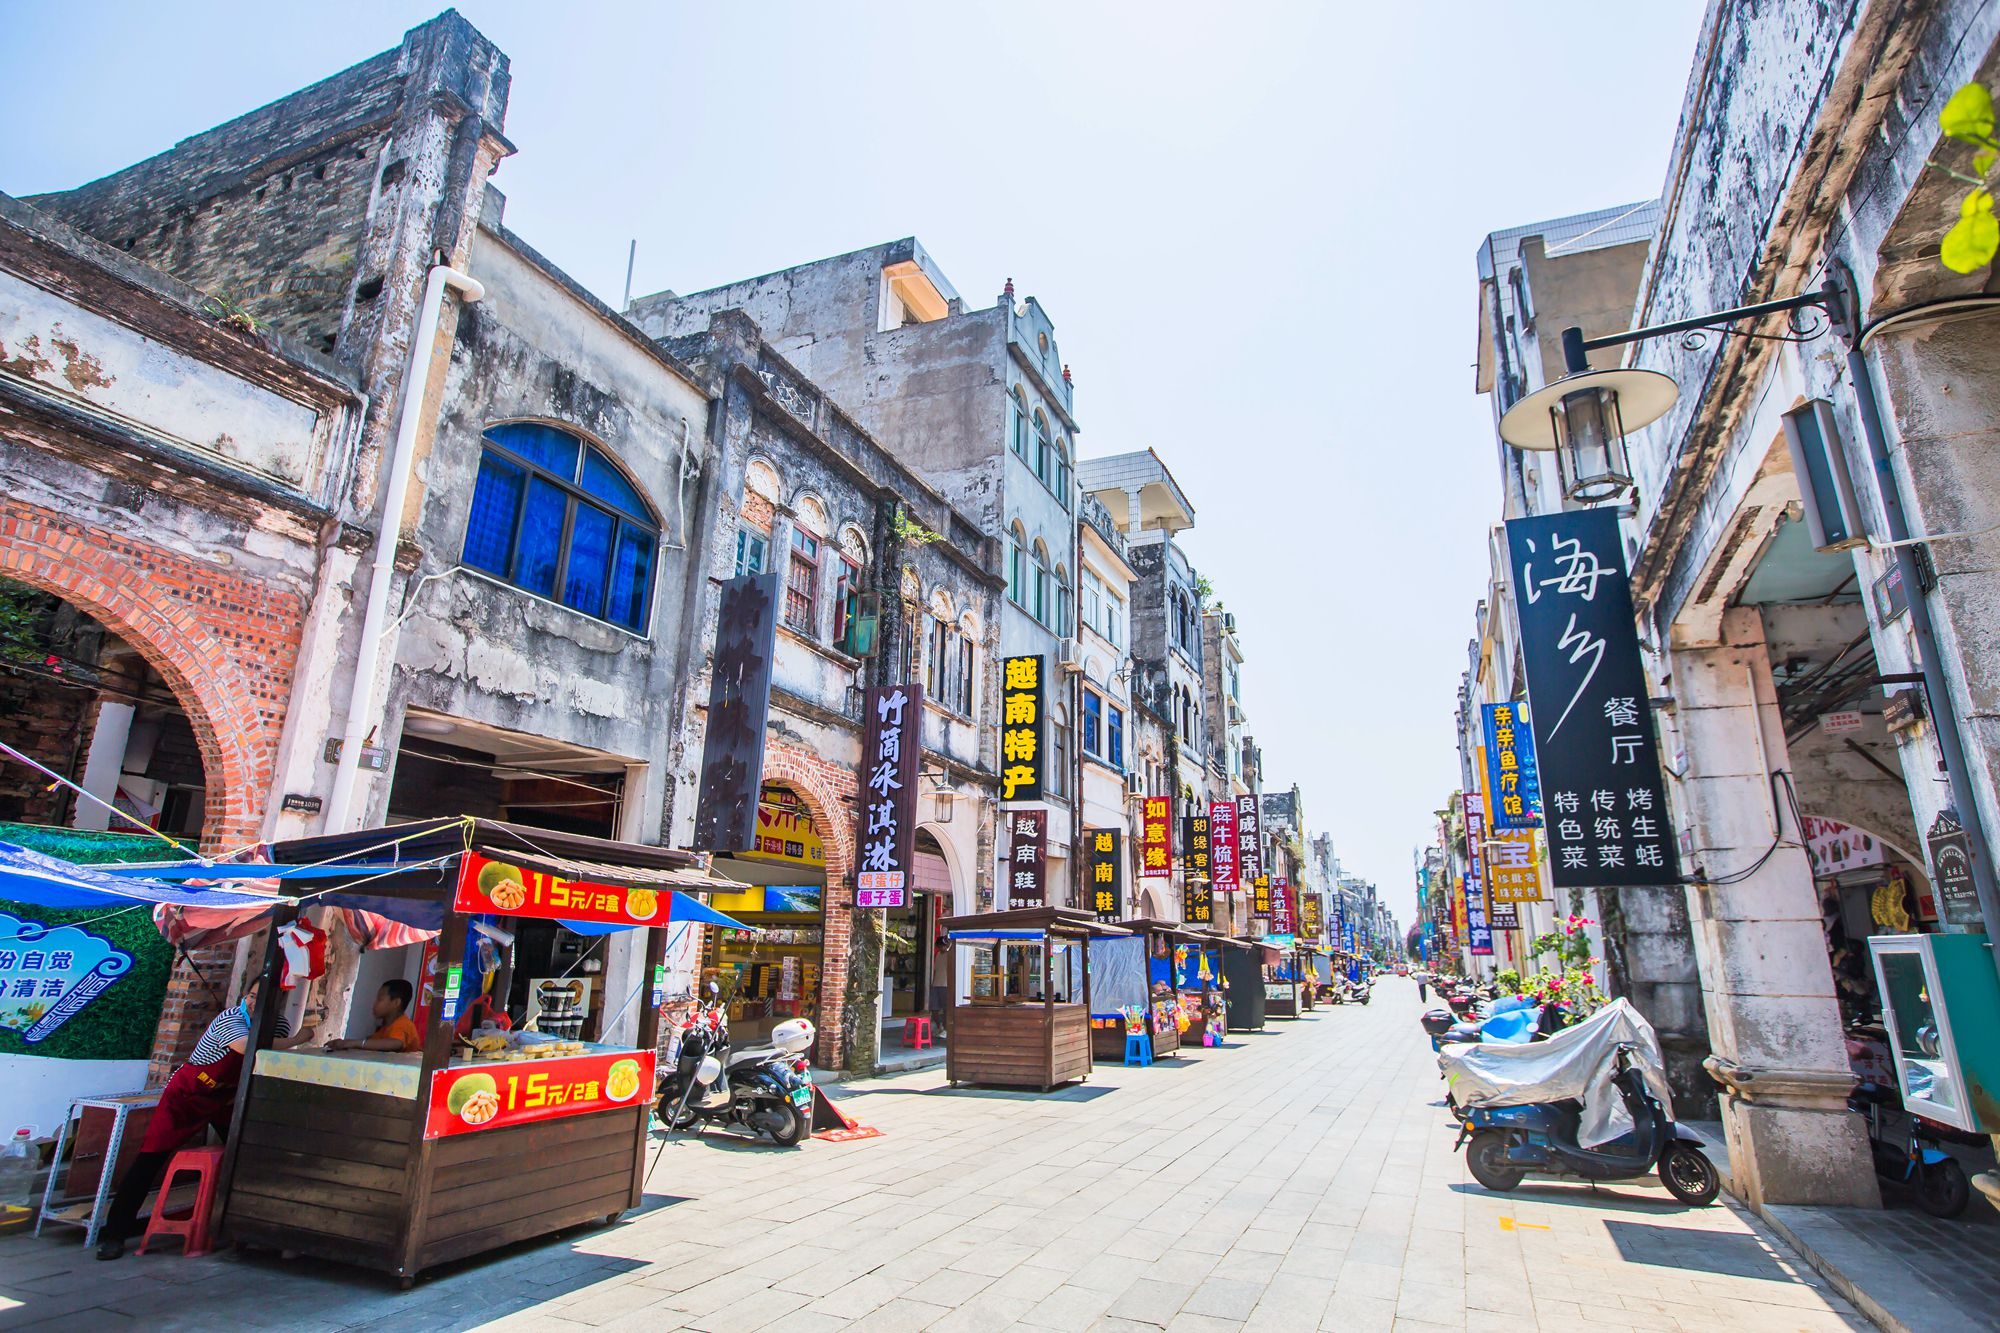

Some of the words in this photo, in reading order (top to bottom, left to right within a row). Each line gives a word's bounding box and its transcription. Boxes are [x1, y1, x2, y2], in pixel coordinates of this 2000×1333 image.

[1524, 533, 1617, 744] 海乡
[1003, 657, 1037, 799] 越南特产
[1494, 707, 1522, 815] 亲亲鱼疗馆
[1604, 697, 1644, 764] 餐厅
[862, 690, 907, 872] 竹筒冰淇淋
[1014, 819, 1038, 889] 越南鞋
[1145, 800, 1167, 867] 如意缘
[1239, 797, 1259, 878] 良成珠宝
[1554, 791, 1588, 869] 特色菜
[1590, 789, 1625, 868] 传统菜
[1626, 788, 1664, 867] 烤生蚝
[533, 872, 620, 913] 15元/2盒
[859, 890, 903, 906] 椰子蛋
[860, 874, 903, 888] 鸡蛋仔
[1095, 833, 1114, 911] 越南鞋
[1255, 873, 1270, 912] 越南鞋
[507, 1073, 600, 1111] 15元/2盒
